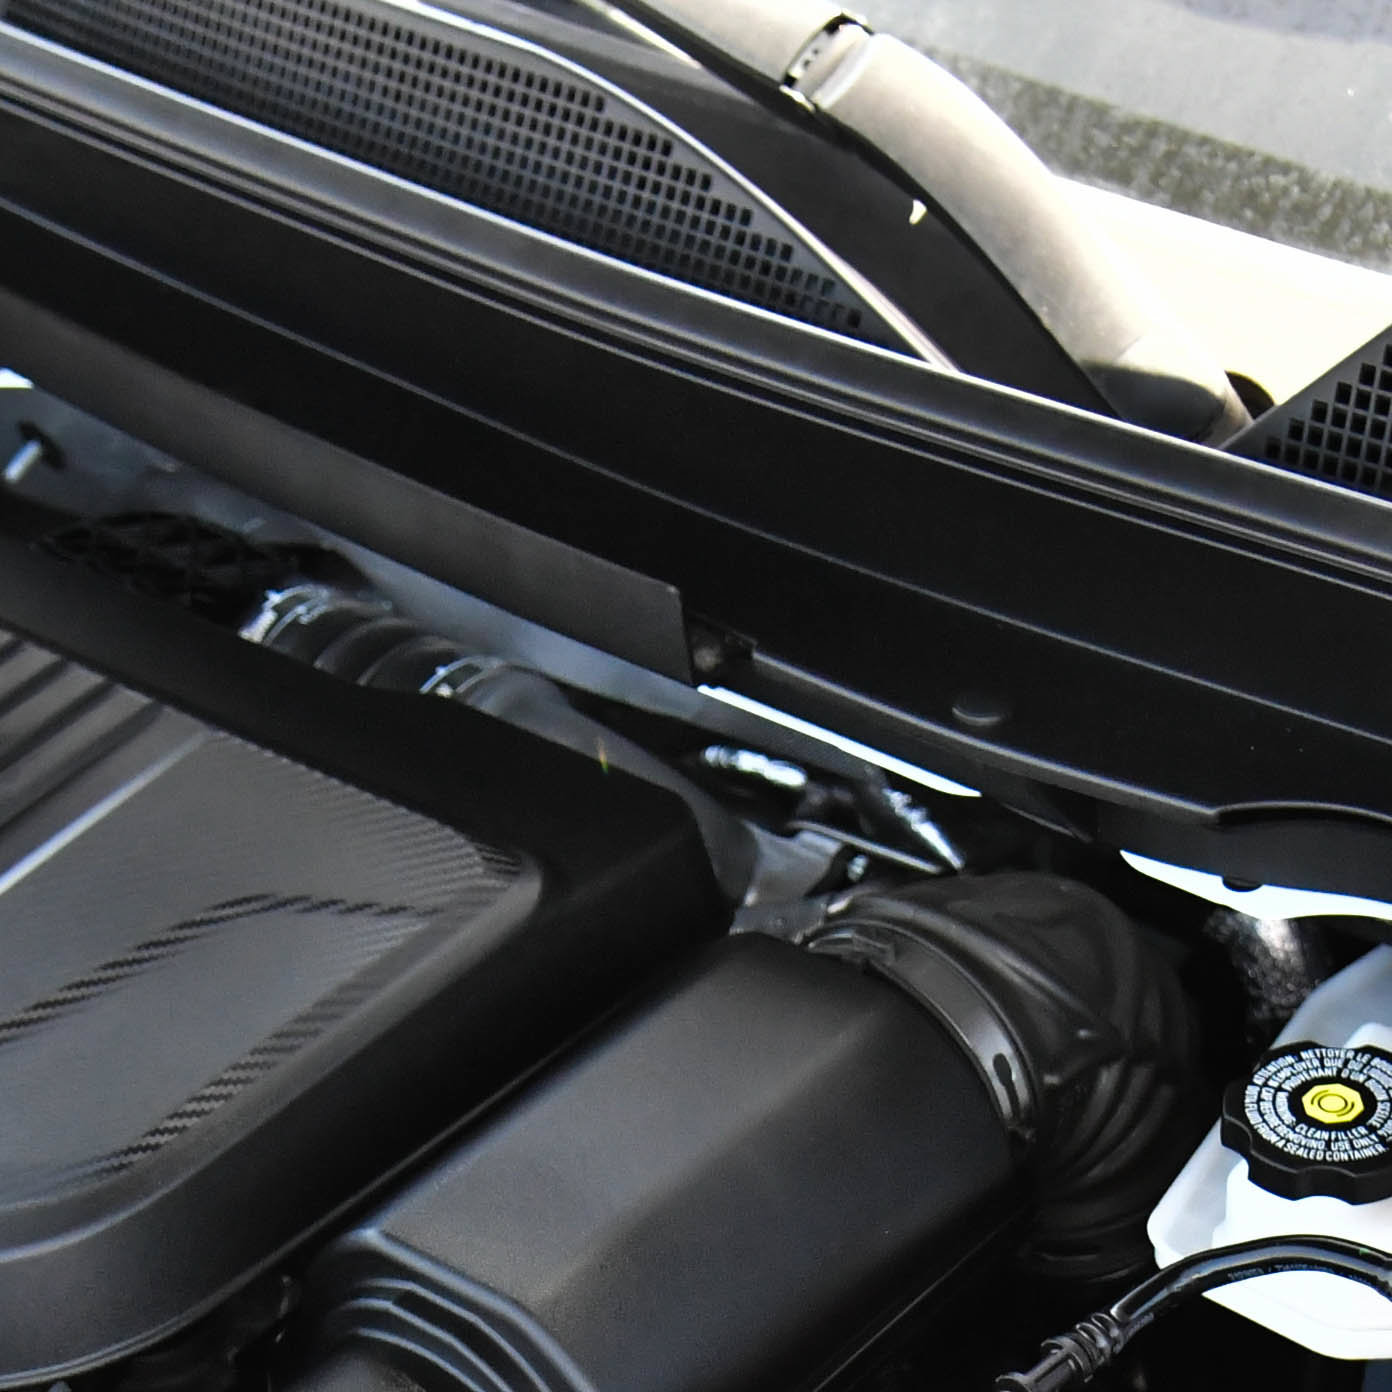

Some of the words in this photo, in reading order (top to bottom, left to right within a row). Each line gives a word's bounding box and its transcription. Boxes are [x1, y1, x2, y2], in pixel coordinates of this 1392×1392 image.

[1300, 1048, 1354, 1061] NETTOYER
[1356, 1053, 1371, 1064] LE
[1324, 1058, 1345, 1068] QUE
[1295, 1123, 1329, 1140] CLEAN
[1331, 1126, 1368, 1140] FILLER
[1331, 1140, 1351, 1151] USE
[1353, 1133, 1379, 1149] ONLY
[1283, 1142, 1324, 1160] SEALED
